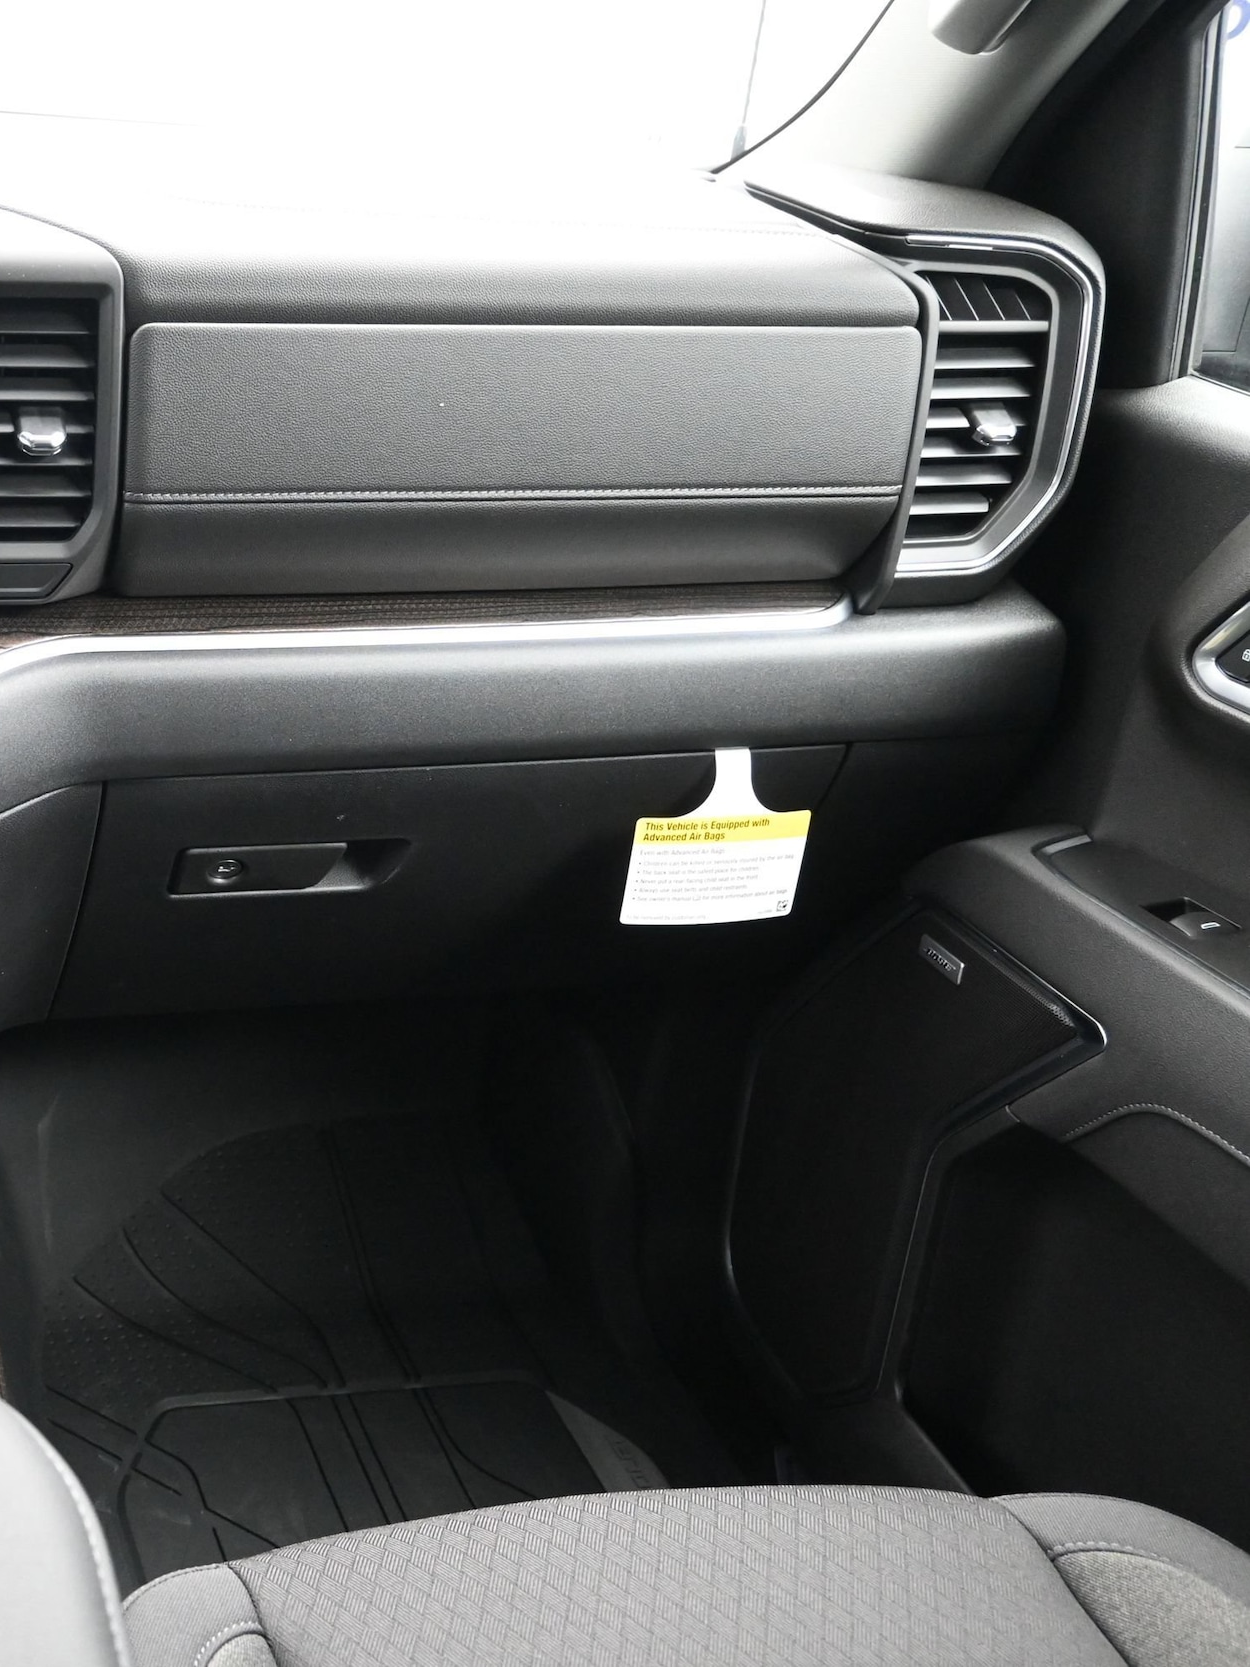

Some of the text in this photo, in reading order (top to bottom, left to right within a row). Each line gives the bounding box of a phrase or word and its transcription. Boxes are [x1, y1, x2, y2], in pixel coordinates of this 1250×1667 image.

[646, 818, 770, 831] This Vehicle is Equipped with
[643, 831, 726, 842] Advanced Air Bags
